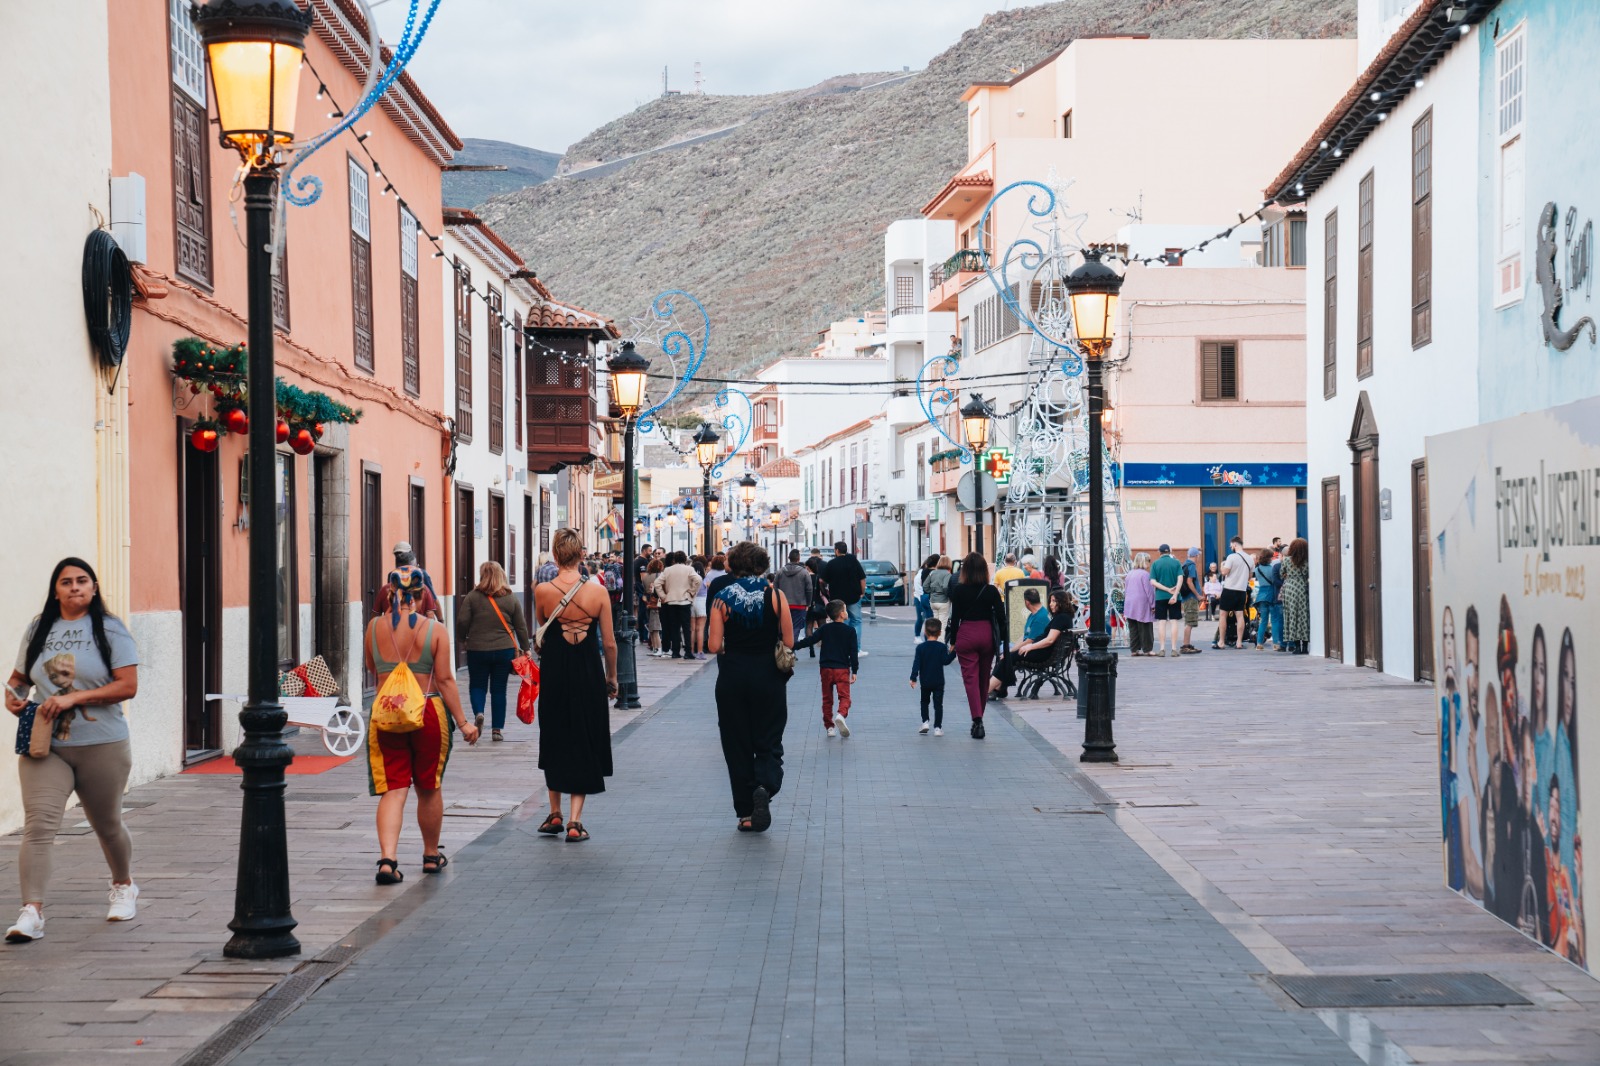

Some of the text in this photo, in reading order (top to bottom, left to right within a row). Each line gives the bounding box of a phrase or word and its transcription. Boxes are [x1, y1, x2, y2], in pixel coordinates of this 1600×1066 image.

[48, 629, 84, 642] I AM
[45, 640, 92, 651] ROOT!
